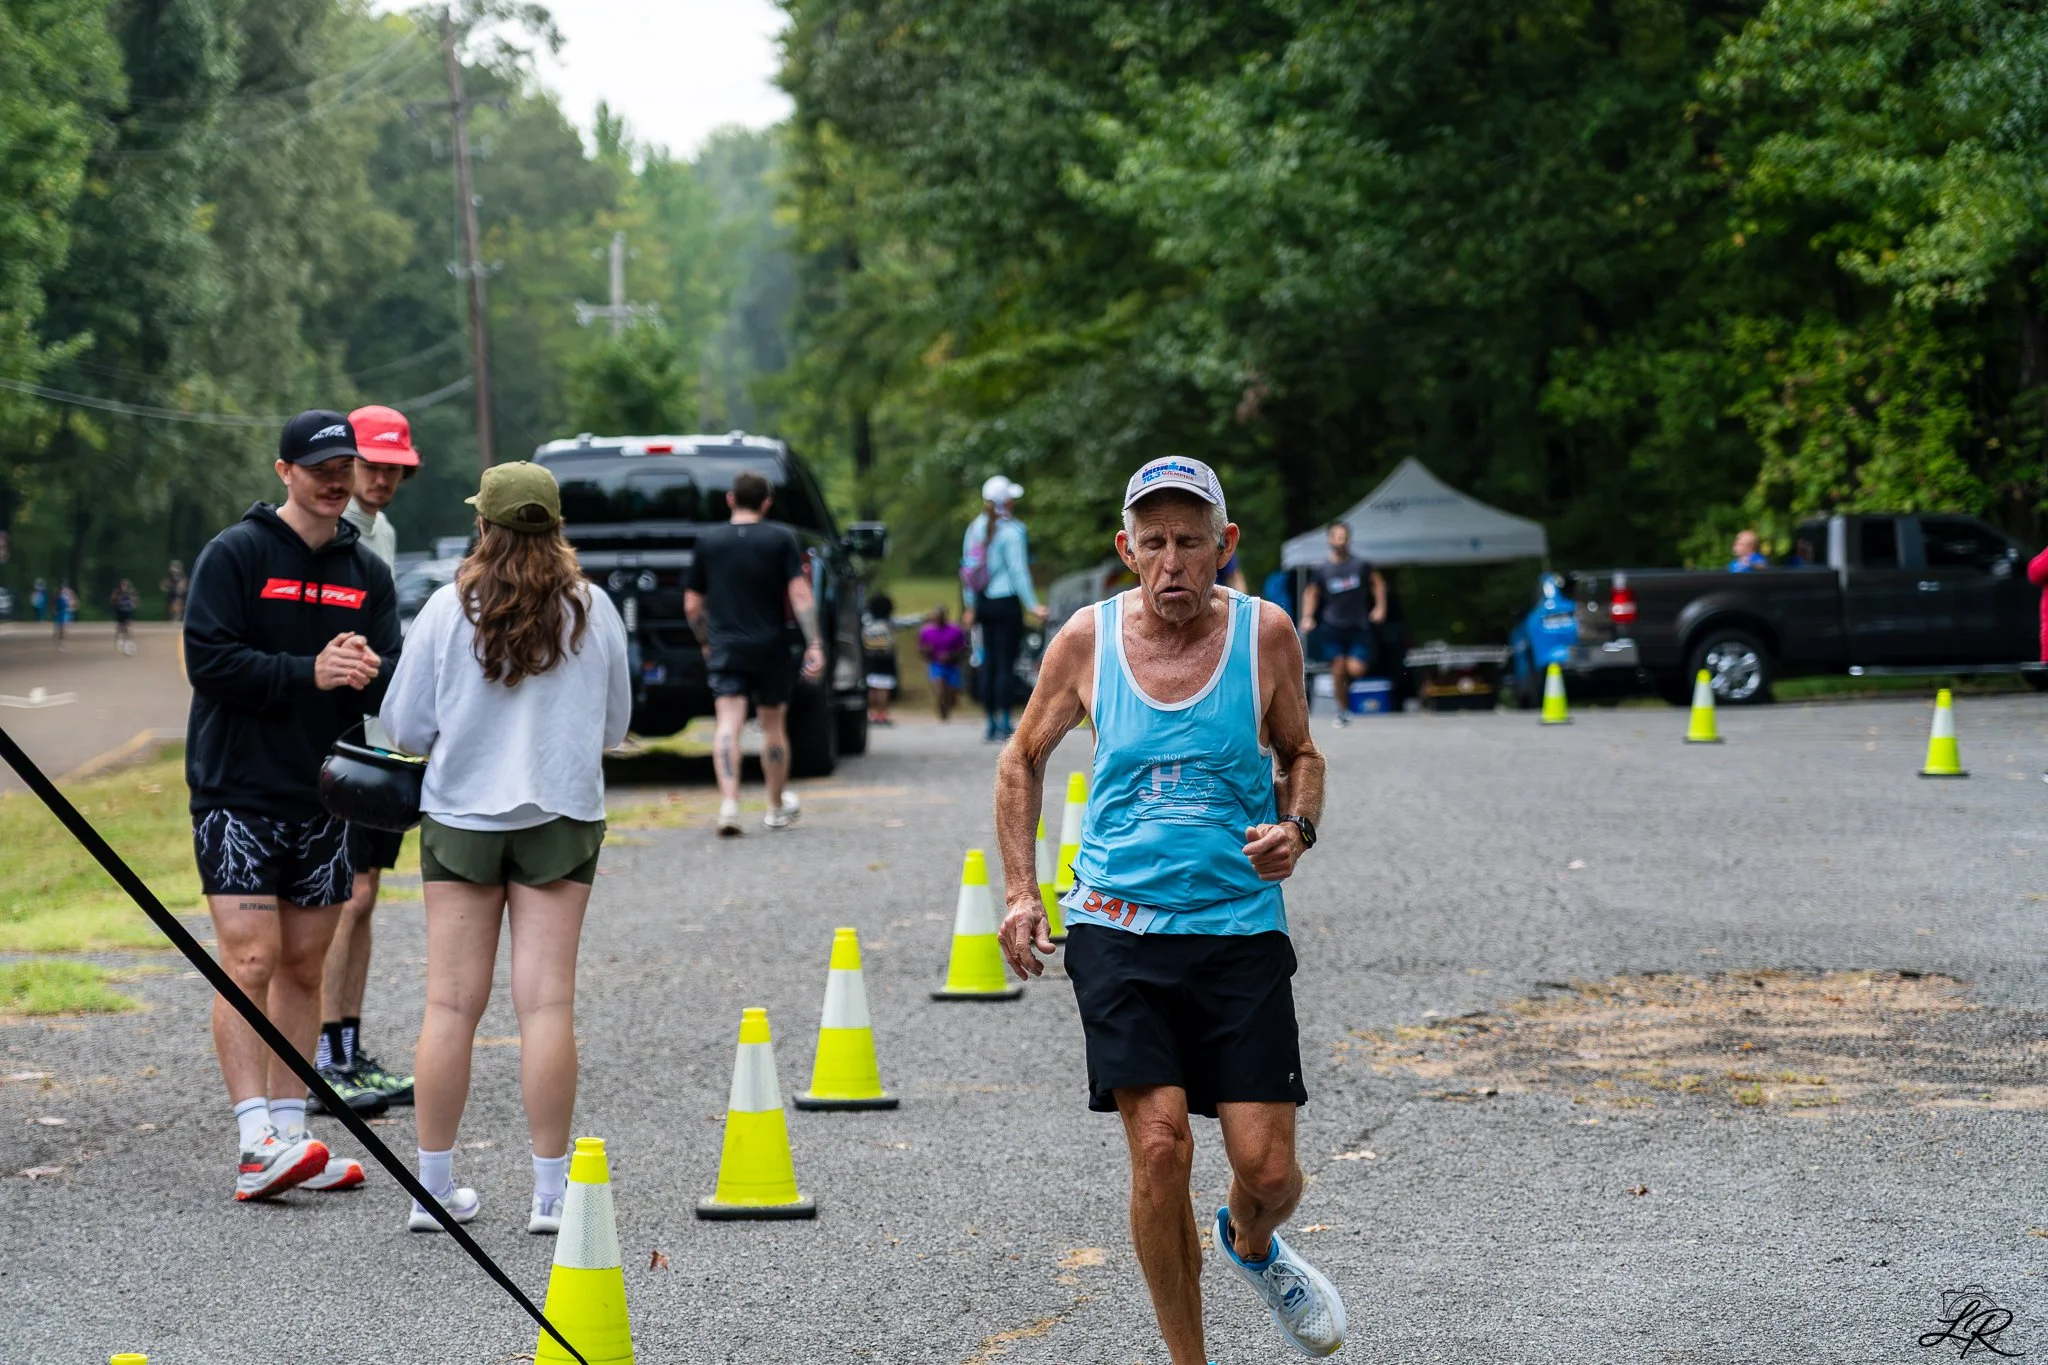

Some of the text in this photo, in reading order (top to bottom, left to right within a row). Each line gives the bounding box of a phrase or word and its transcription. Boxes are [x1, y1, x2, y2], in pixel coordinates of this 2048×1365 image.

[1142, 462, 1196, 479] IRONMAN
[1142, 470, 1161, 485] 70.3
[1083, 890, 1138, 927] 541
